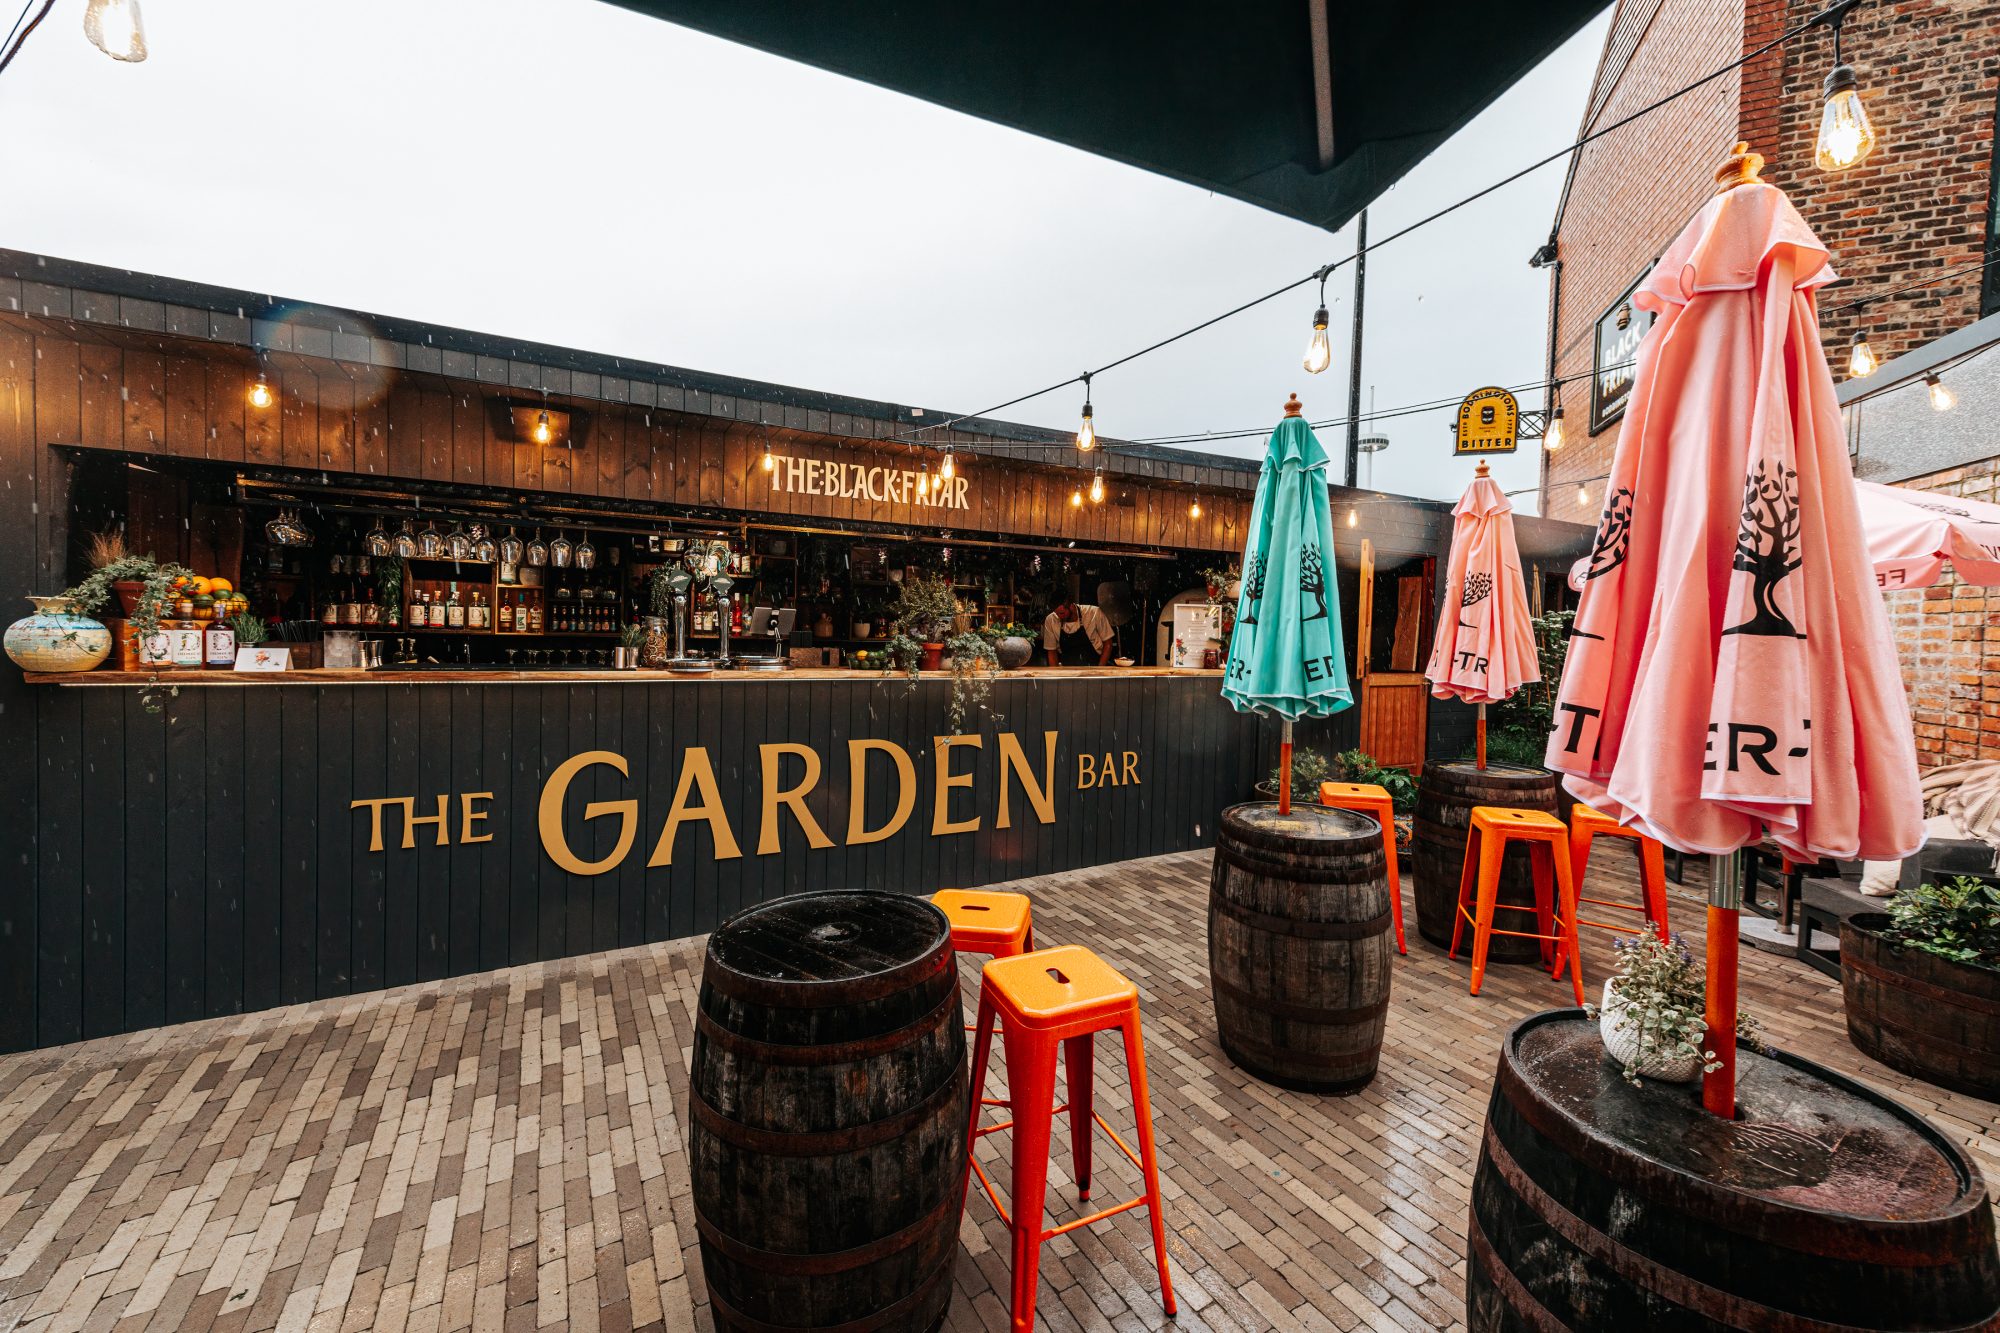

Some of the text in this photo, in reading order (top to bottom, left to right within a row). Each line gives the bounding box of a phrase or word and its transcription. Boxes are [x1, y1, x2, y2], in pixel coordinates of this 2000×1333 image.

[1605, 321, 1641, 366] BLACK
[1462, 391, 1514, 419] BODDINGTONS
[1461, 438, 1512, 448] BITTER
[350, 730, 1141, 876] THE GARDEN BAR
